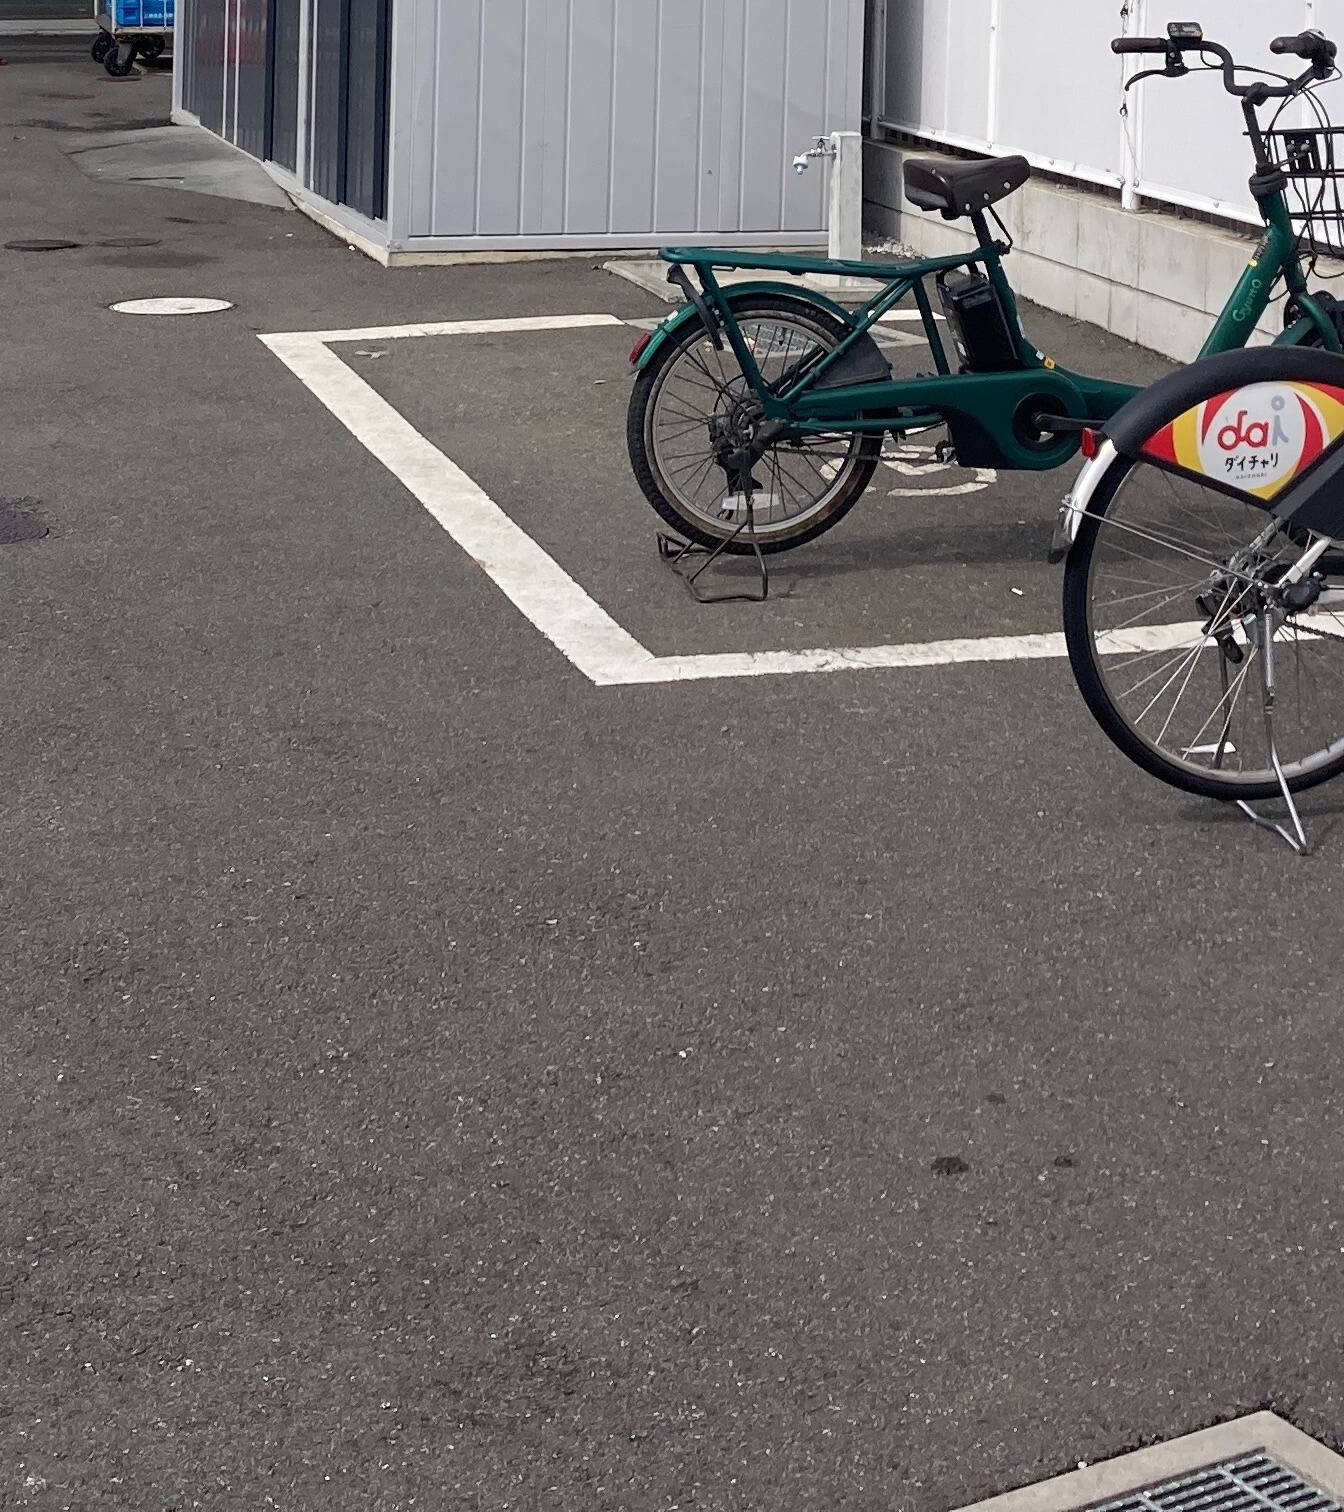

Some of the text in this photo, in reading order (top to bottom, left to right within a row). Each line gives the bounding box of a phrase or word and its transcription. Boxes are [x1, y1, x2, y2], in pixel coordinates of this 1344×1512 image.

[1217, 394, 1289, 451] dai
[1224, 453, 1279, 473] ダイチャリ
